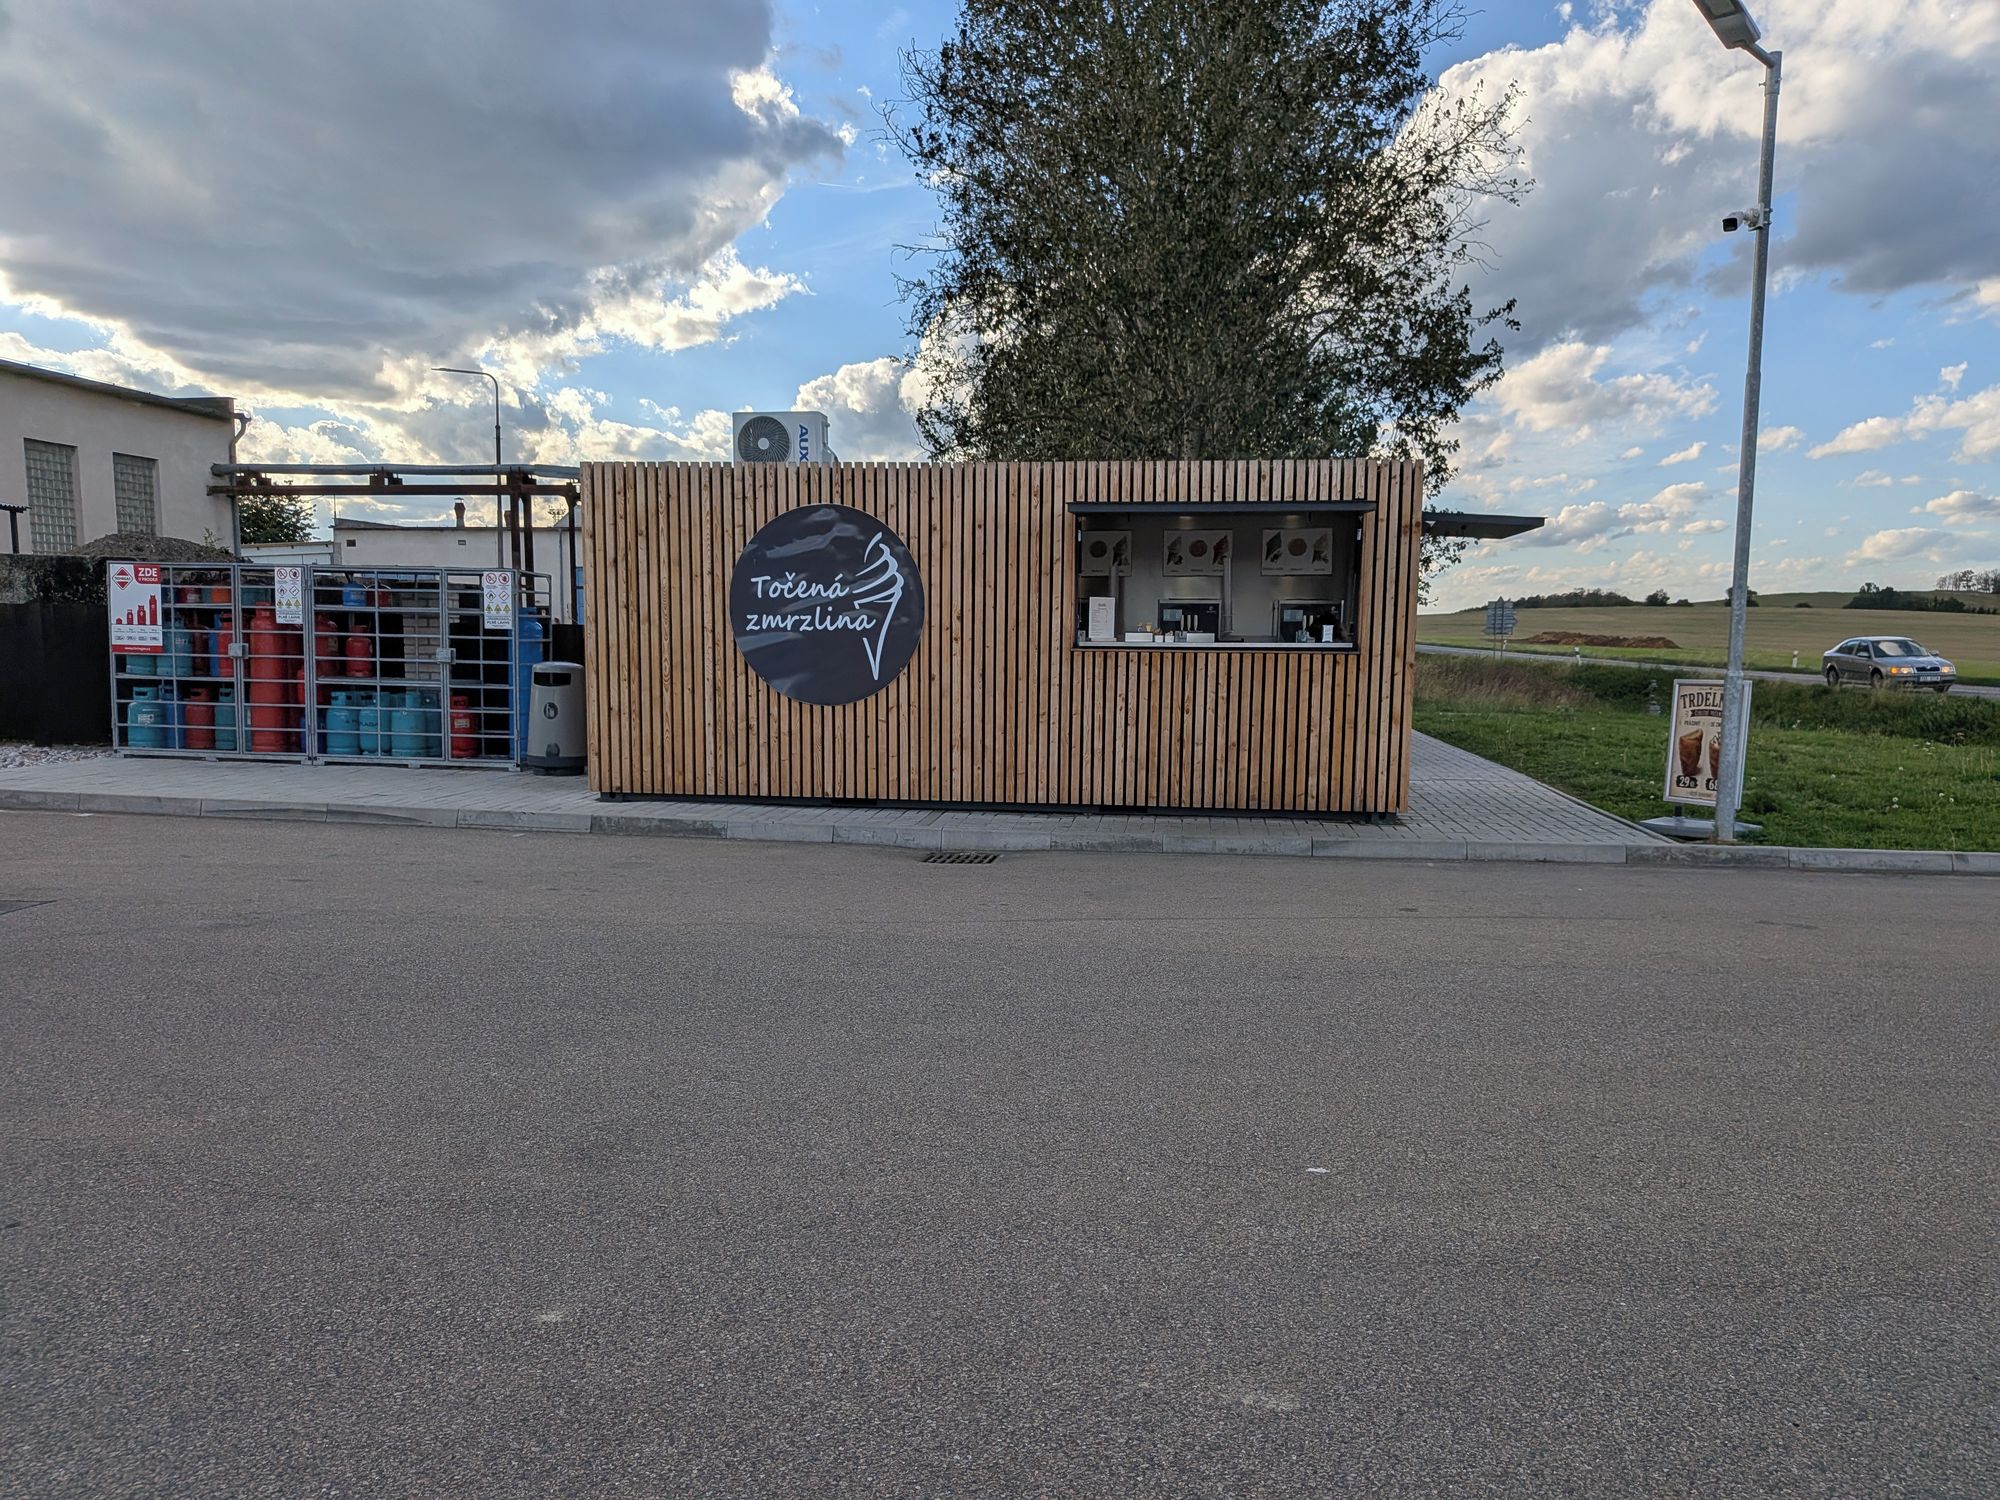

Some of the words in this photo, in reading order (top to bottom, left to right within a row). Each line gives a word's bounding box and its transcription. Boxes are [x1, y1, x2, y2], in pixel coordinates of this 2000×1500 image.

[799, 423, 809, 462] AUX
[138, 567, 158, 577] ZDE
[750, 572, 849, 599] Točená
[746, 606, 876, 632] zmrzlina
[1679, 776, 1690, 787] 29
